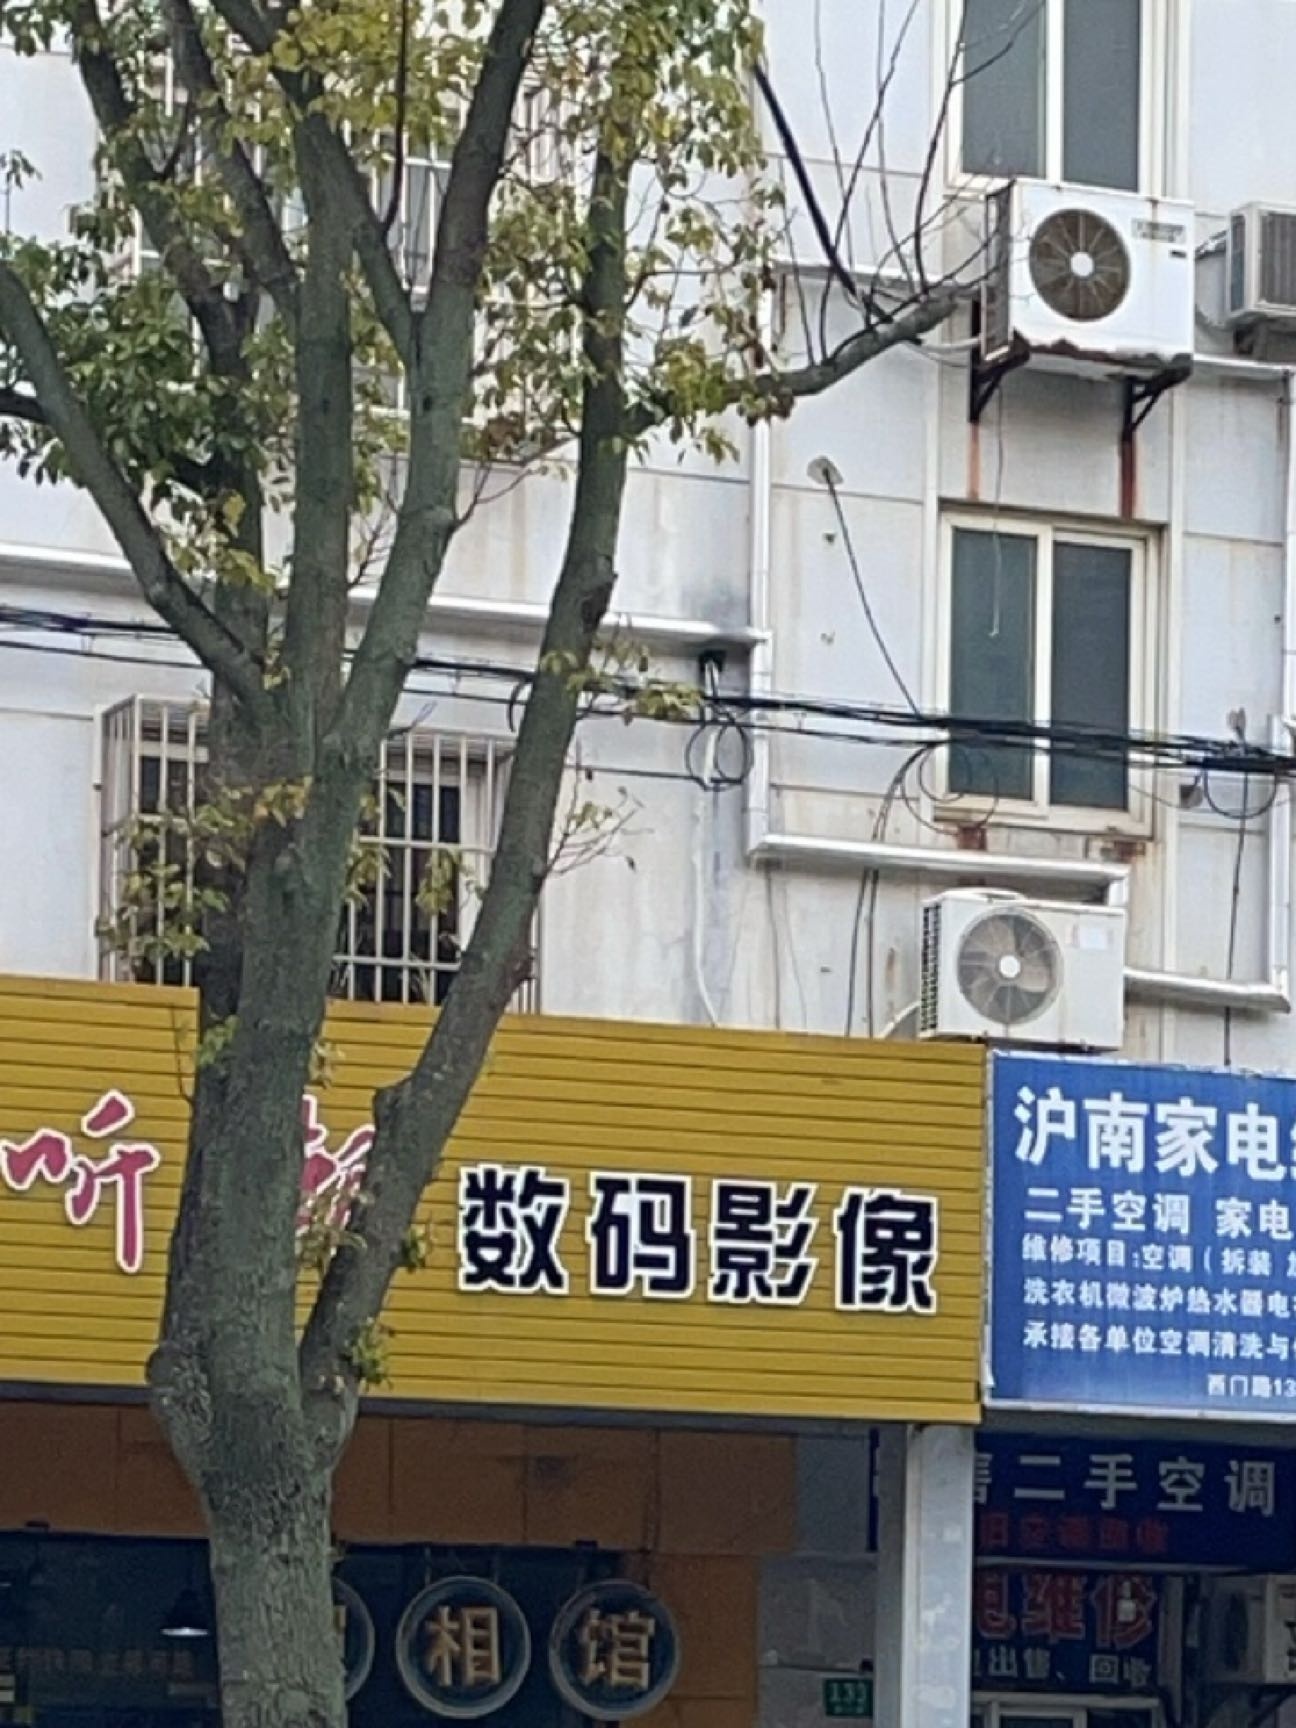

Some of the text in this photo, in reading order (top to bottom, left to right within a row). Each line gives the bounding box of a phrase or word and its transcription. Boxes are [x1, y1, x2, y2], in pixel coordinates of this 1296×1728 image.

[458, 1165, 938, 1315] 数码影像
[1024, 1187, 1191, 1237] 二手空调
[1215, 1198, 1294, 1240] 家电
